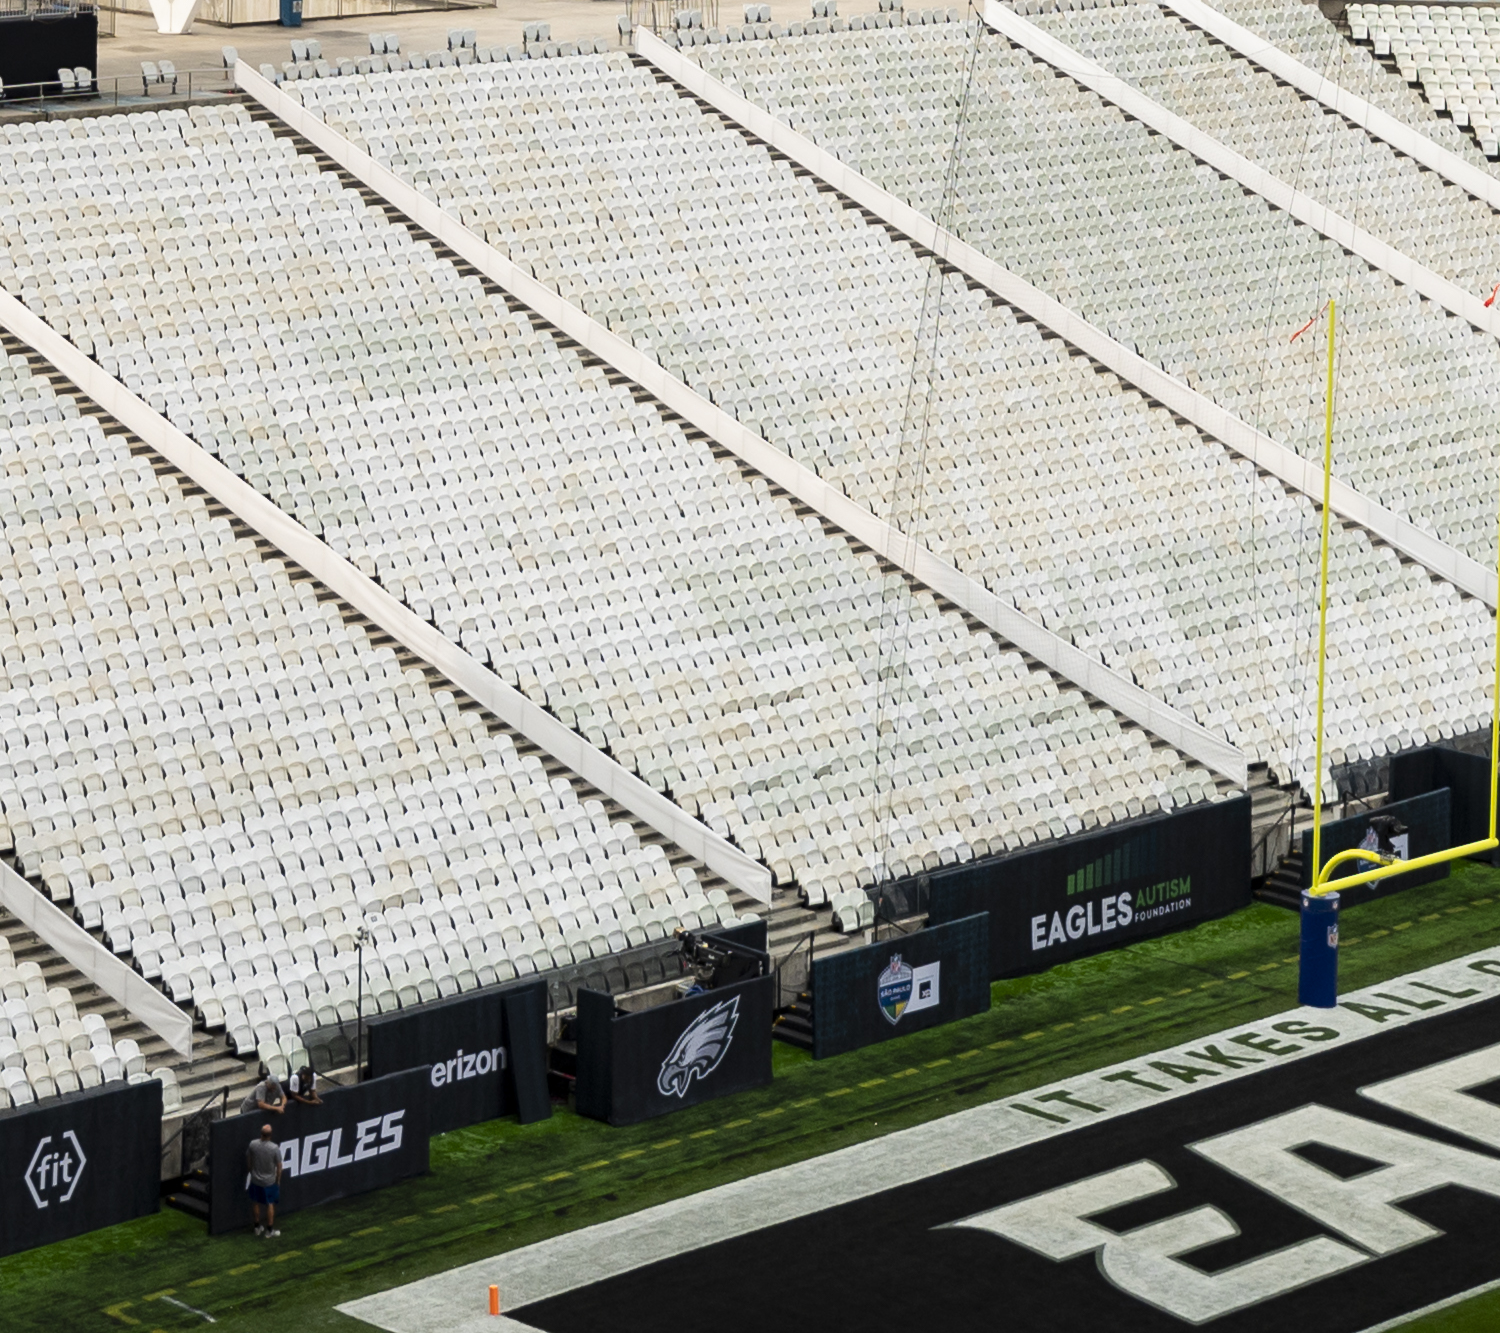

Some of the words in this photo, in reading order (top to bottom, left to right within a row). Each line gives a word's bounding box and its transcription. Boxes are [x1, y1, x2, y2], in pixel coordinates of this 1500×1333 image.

[1134, 897, 1192, 923] FOUNDATION
[1135, 874, 1191, 909] AUTISM
[1031, 891, 1133, 951] EAGLES
[430, 1046, 507, 1088] erizon
[1009, 1090, 1107, 1125] IT
[1100, 1020, 1341, 1093] TAKES
[1337, 982, 1482, 1023] ALL
[278, 1108, 406, 1178] AGLES
[36, 1151, 73, 1191] fit
